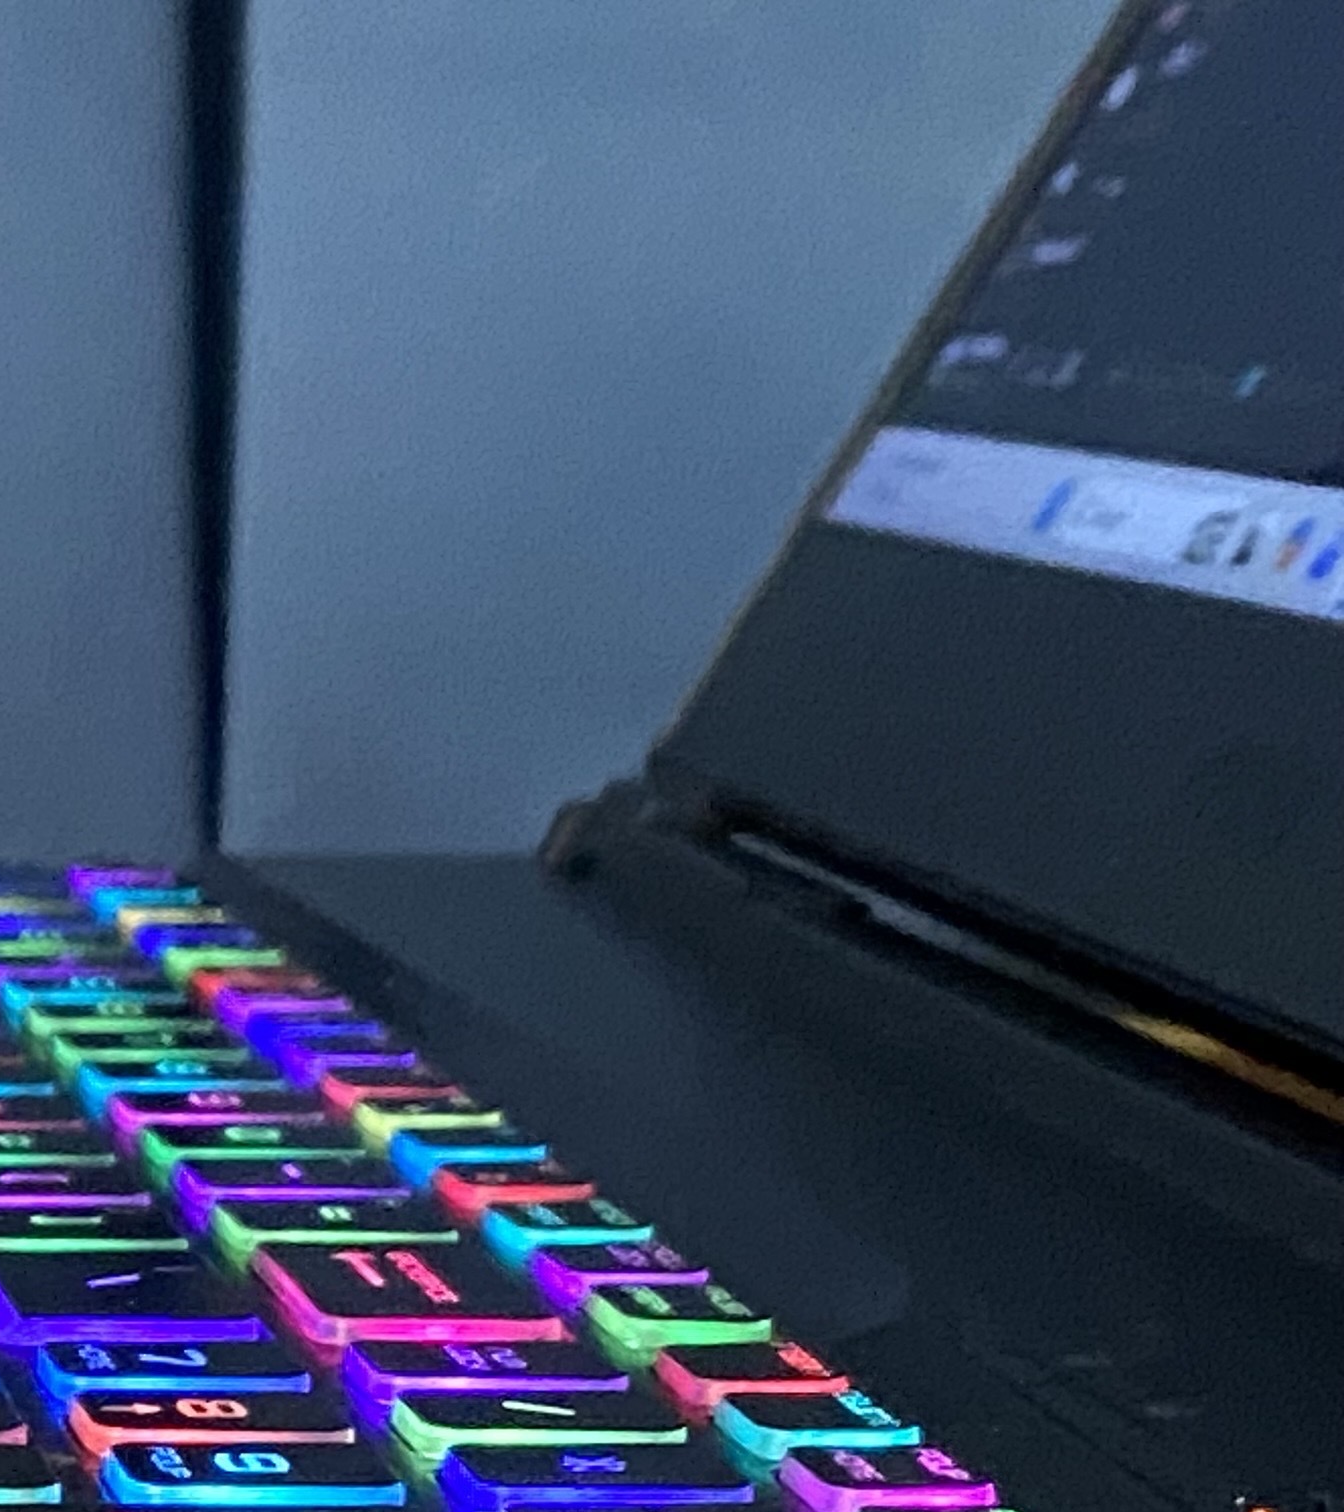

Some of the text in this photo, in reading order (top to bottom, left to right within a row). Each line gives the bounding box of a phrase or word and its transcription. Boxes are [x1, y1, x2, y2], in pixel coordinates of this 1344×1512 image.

[140, 1348, 207, 1367] 7
[176, 1397, 248, 1419] 8
[213, 1452, 290, 1475] 9
